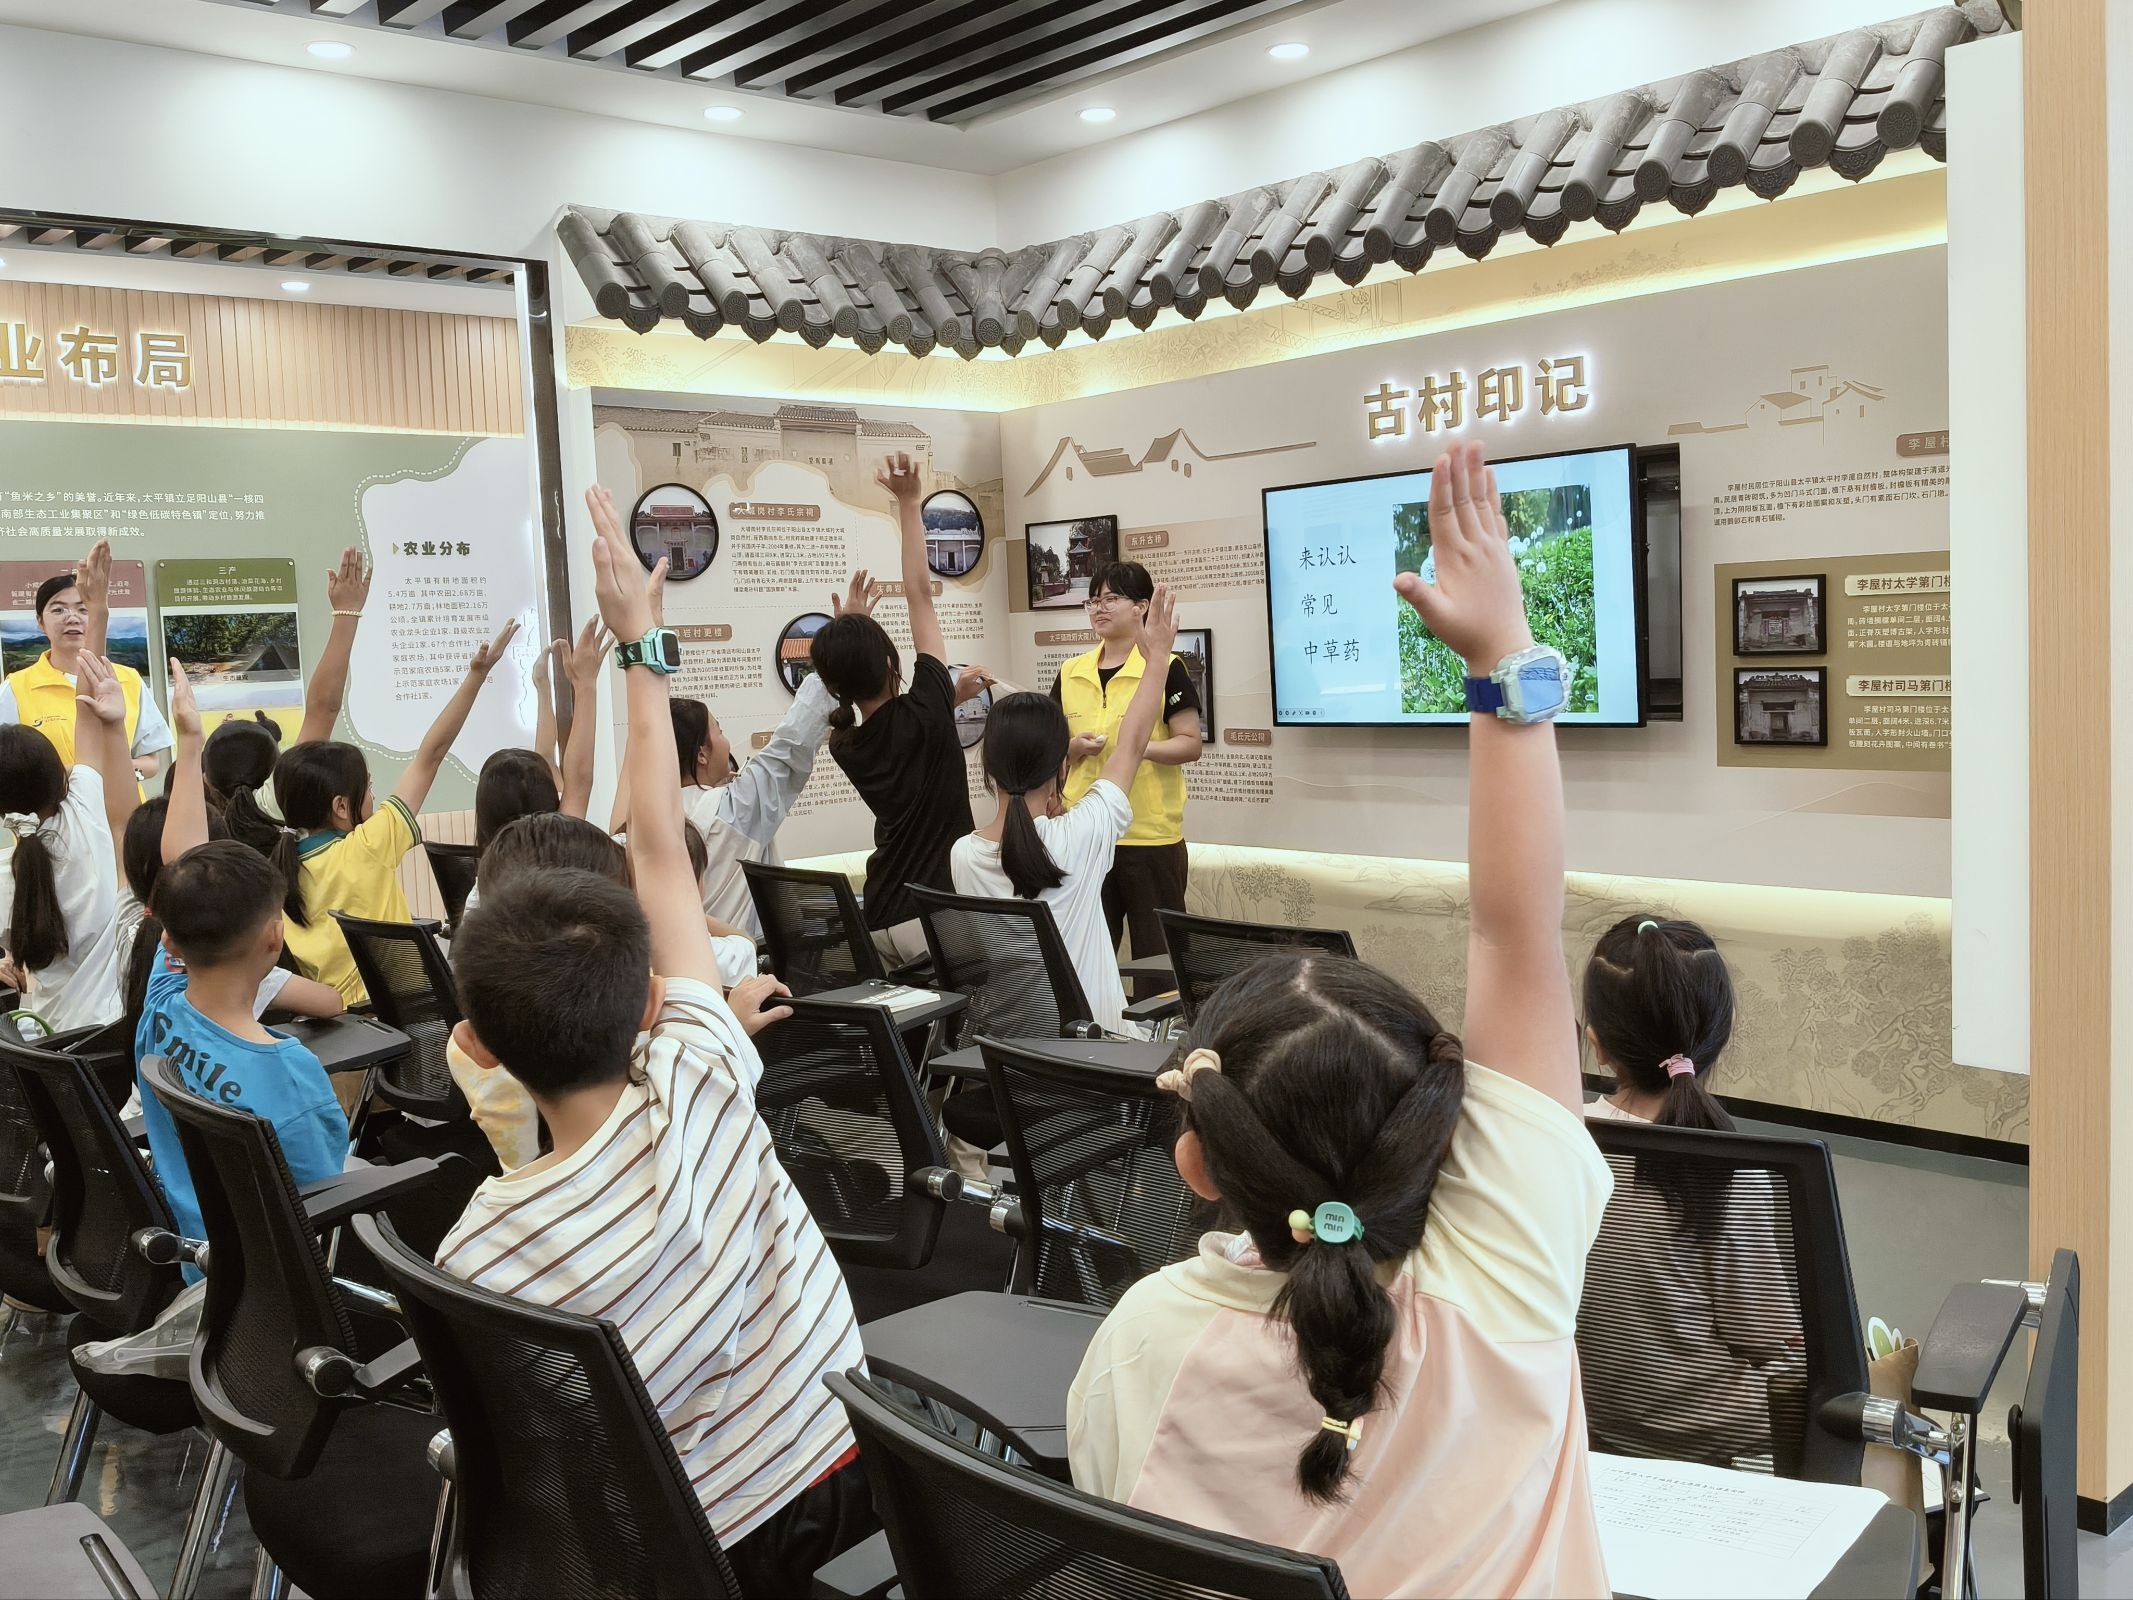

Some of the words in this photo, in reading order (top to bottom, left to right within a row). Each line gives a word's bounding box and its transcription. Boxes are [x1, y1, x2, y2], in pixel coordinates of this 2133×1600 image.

[0, 322, 191, 388] 业布局
[1363, 355, 1590, 441] 古村印记
[403, 541, 471, 556] 农业分布
[1299, 545, 1357, 571] 来认认
[1301, 593, 1338, 619] 常见
[1862, 602, 1951, 614] 李屋村太学第门楼位于太
[1304, 638, 1360, 665] 中草药
[1863, 705, 1951, 715] 李屋村司马第门楼位于太
[154, 1012, 241, 1103] Smile
[1323, 1222, 1343, 1233] min
[1325, 1213, 1345, 1223] min
